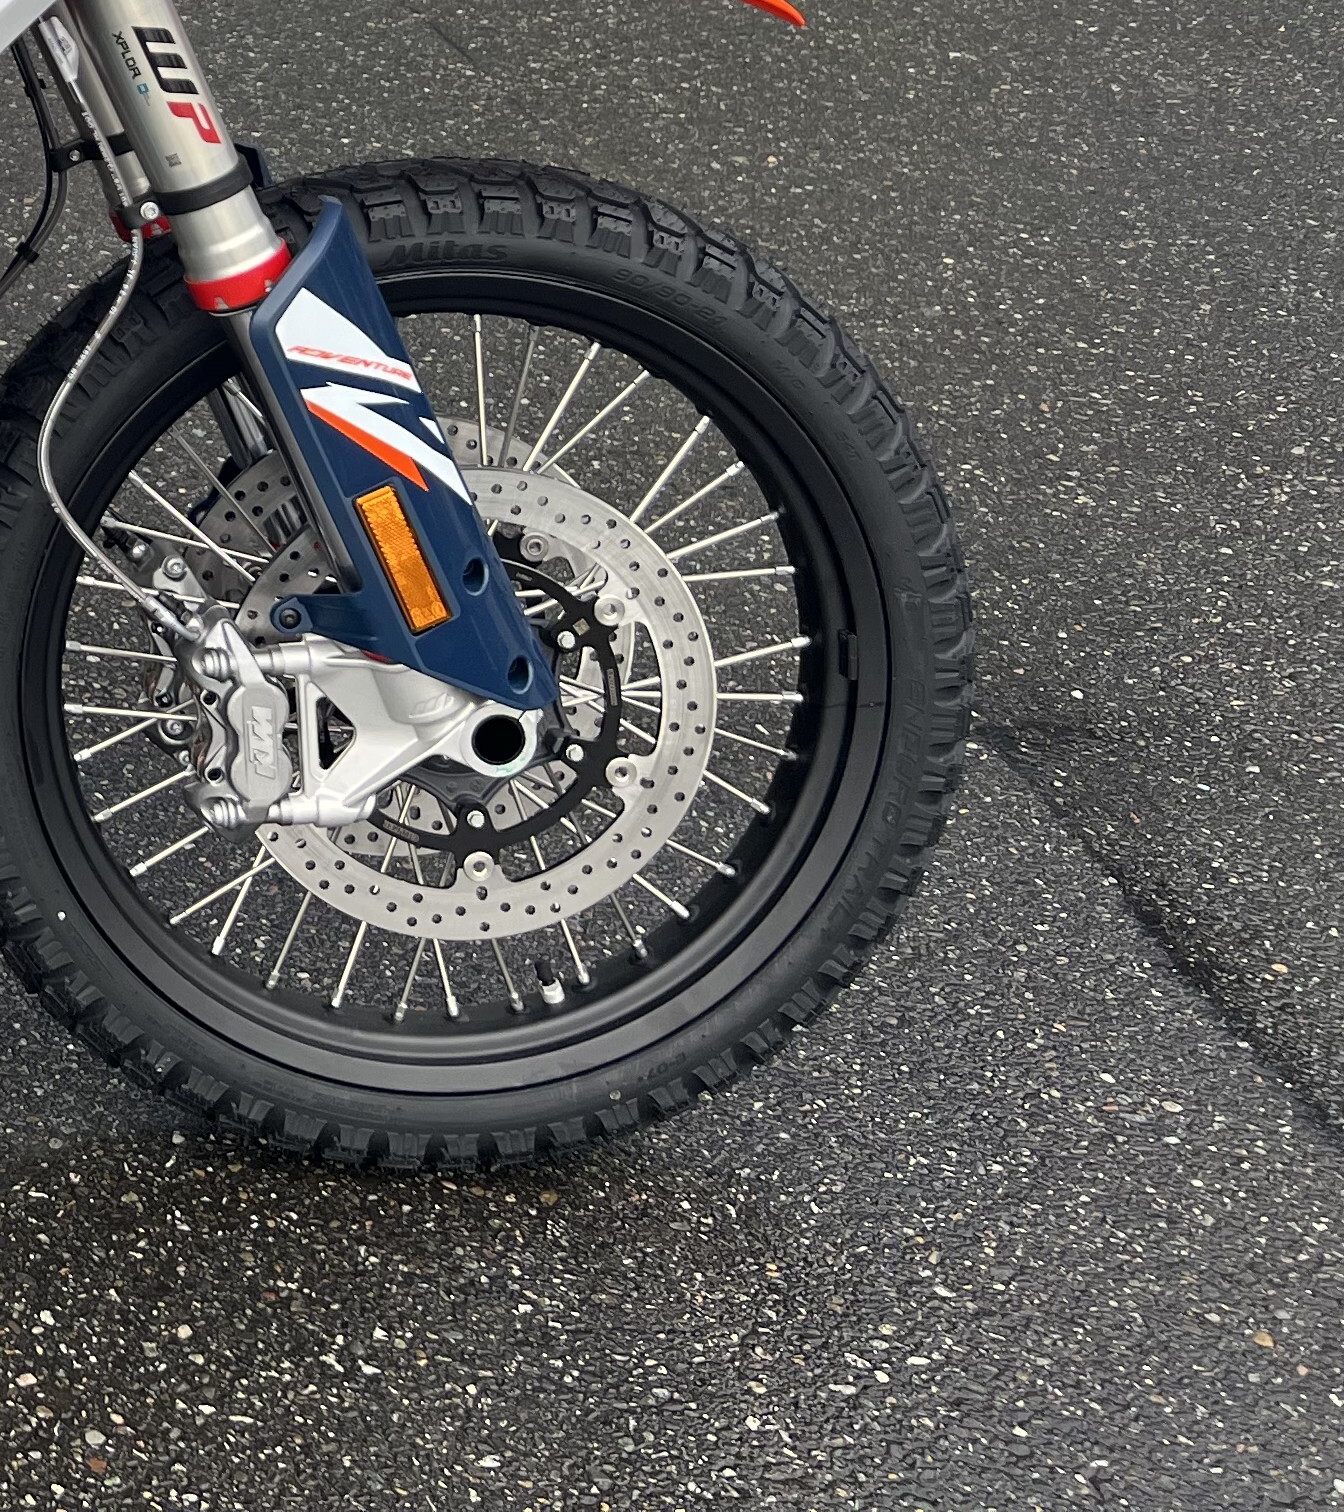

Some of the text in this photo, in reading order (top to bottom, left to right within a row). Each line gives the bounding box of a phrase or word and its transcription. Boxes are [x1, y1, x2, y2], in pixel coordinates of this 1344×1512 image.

[112, 30, 142, 80] XPLOR
[130, 25, 222, 145] WP
[385, 240, 509, 268] Mitas
[287, 345, 413, 382] ADVENTURE
[247, 705, 276, 780] KTM
